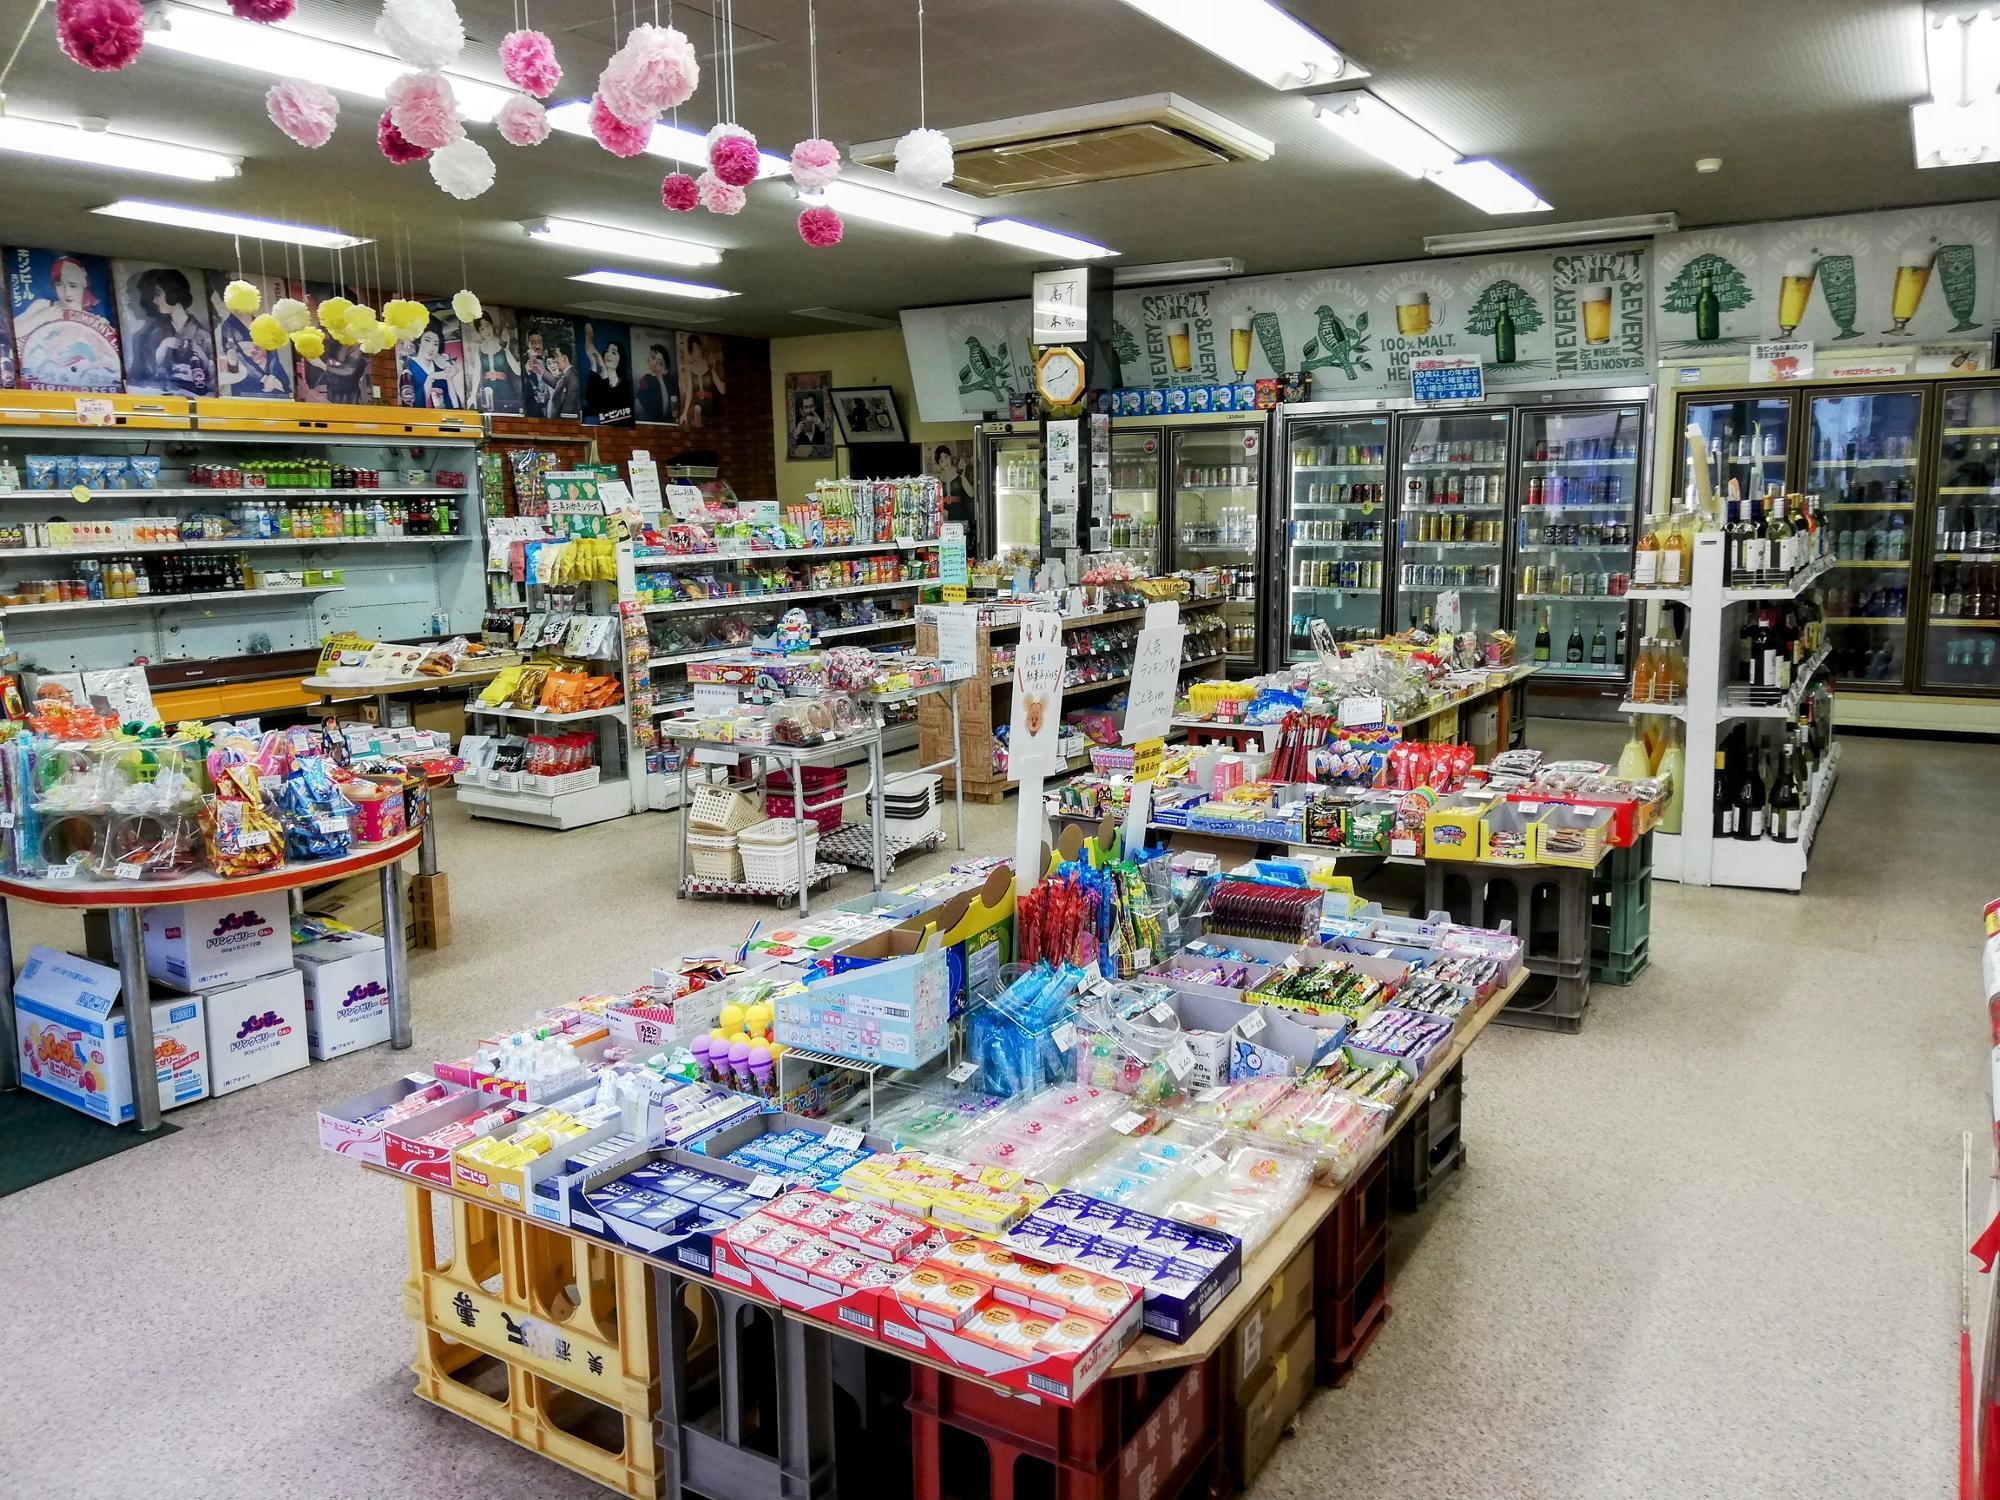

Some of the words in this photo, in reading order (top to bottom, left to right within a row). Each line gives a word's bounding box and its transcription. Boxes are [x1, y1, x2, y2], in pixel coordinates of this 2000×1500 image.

[1691, 260, 1722, 277] BEER
[1490, 286, 1516, 301] BEER
[1620, 282, 1644, 298] &
[1674, 295, 1697, 308] MILD
[69, 310, 111, 337] COMPANY
[1476, 321, 1496, 330] MILD
[1554, 287, 1577, 348] EVERY
[1621, 298, 1644, 356] EVERY
[1381, 338, 1415, 352] 100%
[1417, 334, 1456, 349] MALT.
[1197, 331, 1219, 384] EVERY
[1415, 368, 1478, 379] 20歳以上の年齢で
[1415, 375, 1479, 386] あることを確認でき
[1416, 383, 1479, 392] ない場合には酒類を
[1416, 390, 1480, 400] 販売しません
[206, 931, 256, 950] ドリンクゼリー
[337, 1001, 378, 1020] ドリンクゼリー
[230, 1031, 275, 1052] ドリンクゼリー
[50, 1062, 79, 1080] ミニゼリー
[401, 1139, 436, 1158] ミニコーラ
[456, 1165, 489, 1187] ミニビタ
